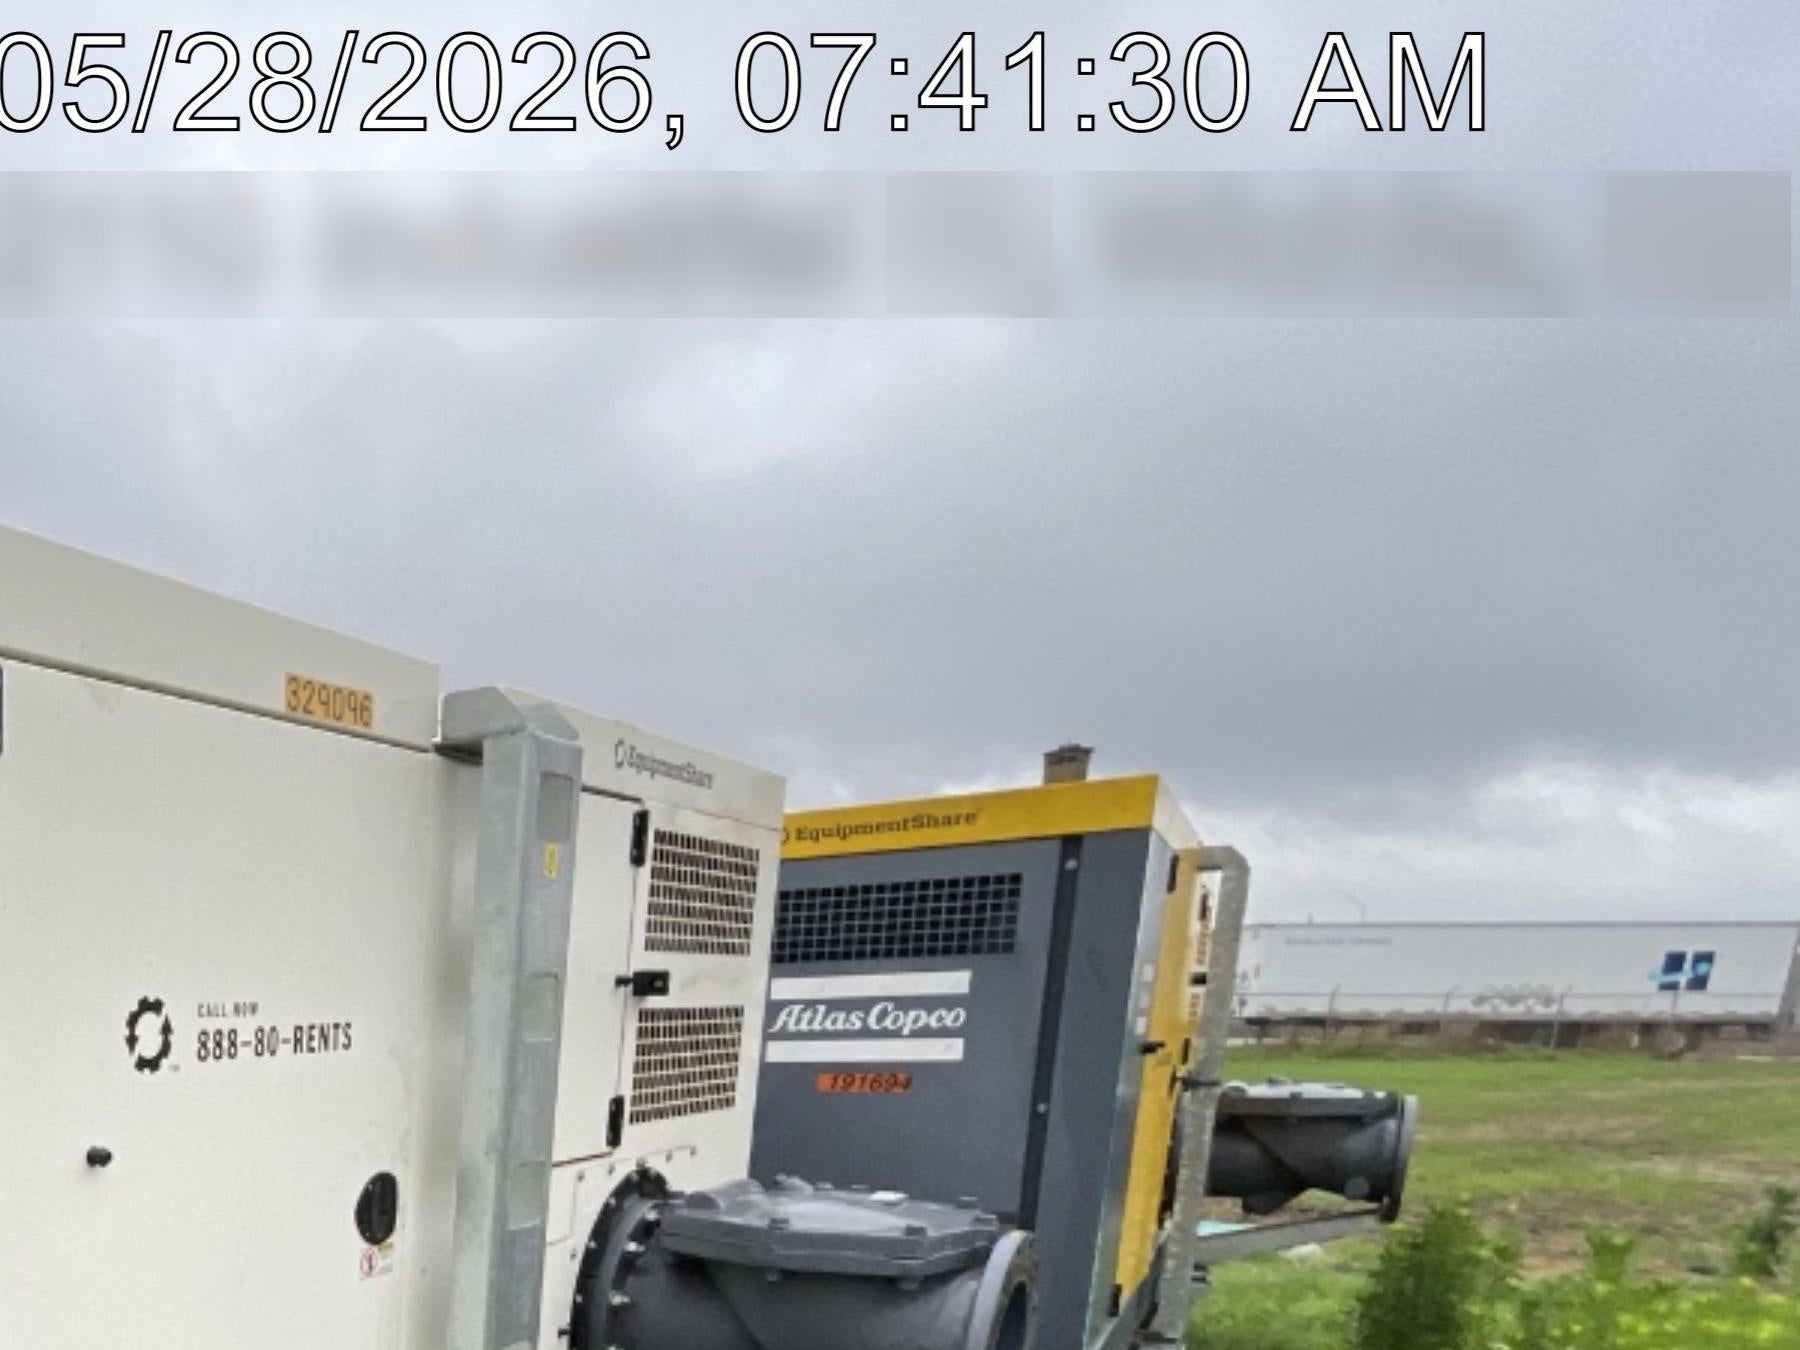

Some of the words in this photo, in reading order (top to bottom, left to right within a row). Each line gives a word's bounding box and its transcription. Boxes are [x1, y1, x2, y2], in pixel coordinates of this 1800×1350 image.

[287, 674, 373, 728] 329096
[795, 812, 977, 843] EquipmentShare
[197, 1002, 227, 1018] CALL
[233, 1001, 258, 1017] NOW
[196, 1021, 353, 1063] 888-80-RENTS
[829, 1072, 912, 1092] 191694
